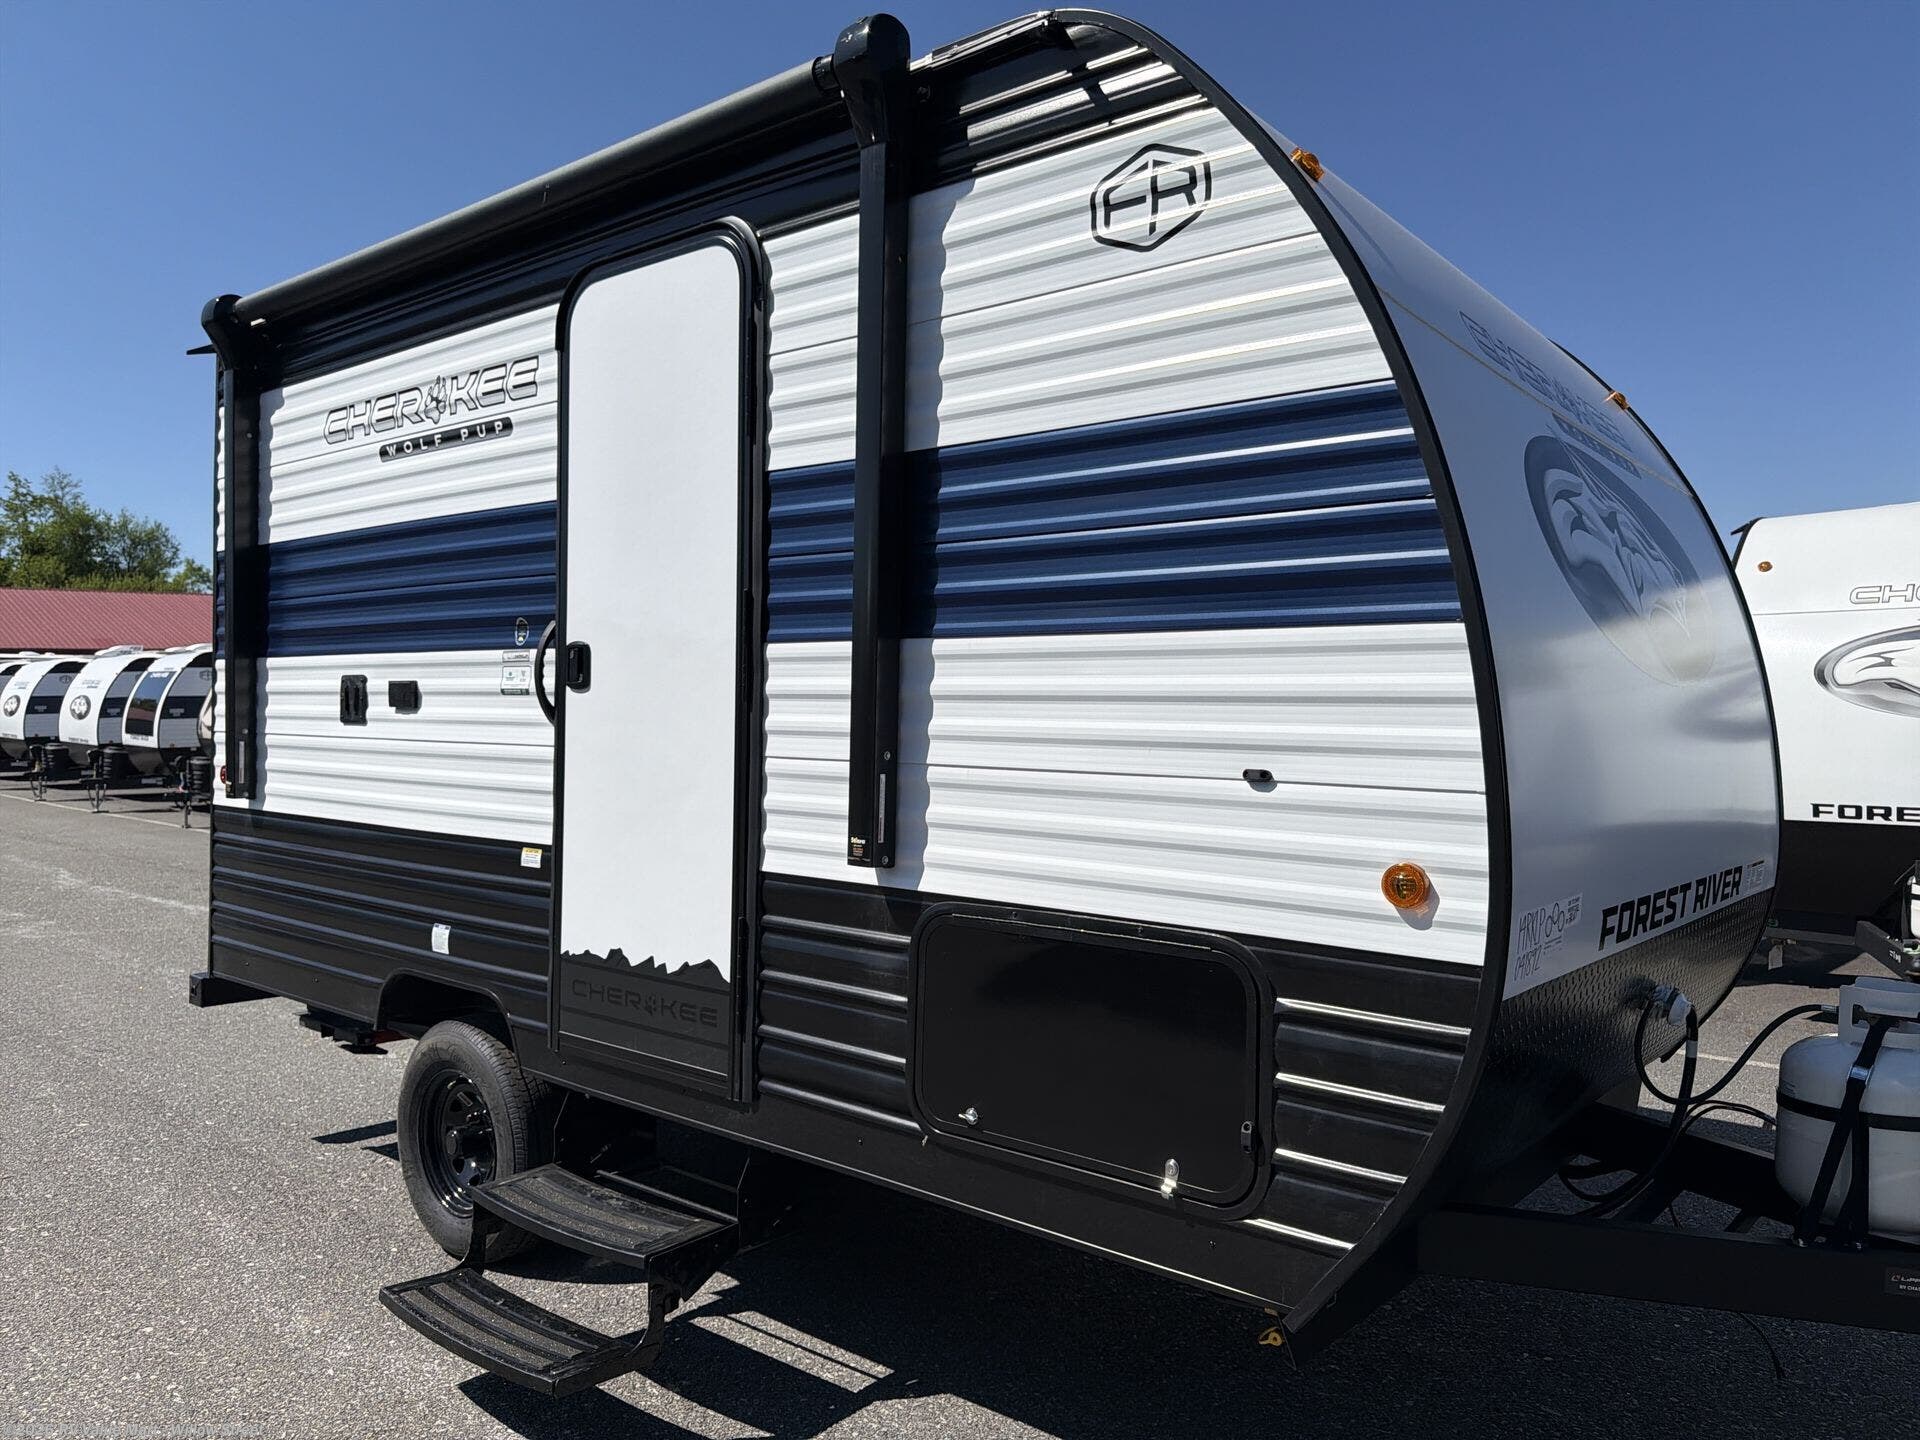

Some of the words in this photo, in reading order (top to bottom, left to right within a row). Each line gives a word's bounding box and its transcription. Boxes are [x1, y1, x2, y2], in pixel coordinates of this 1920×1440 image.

[386, 434, 443, 457] WOLF
[460, 421, 504, 442] PUP
[1598, 881, 1692, 952] FOREST
[1693, 865, 1743, 914] RIVER
